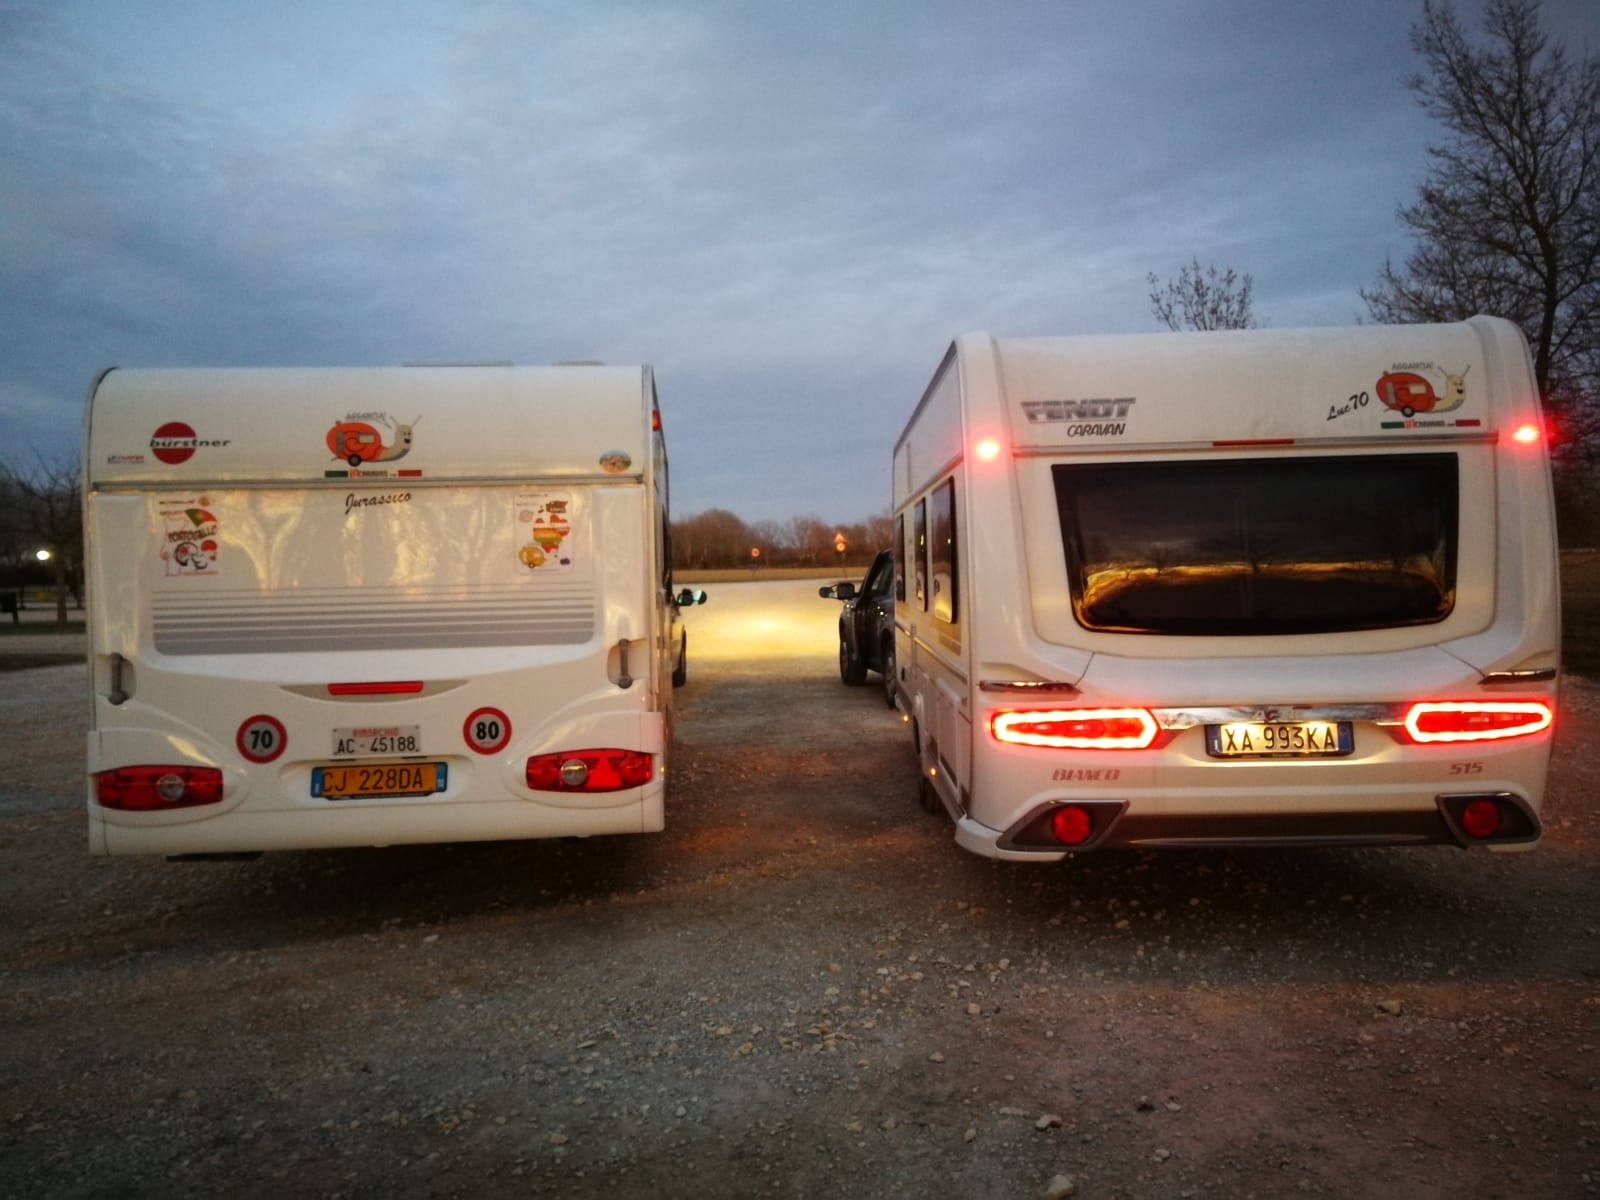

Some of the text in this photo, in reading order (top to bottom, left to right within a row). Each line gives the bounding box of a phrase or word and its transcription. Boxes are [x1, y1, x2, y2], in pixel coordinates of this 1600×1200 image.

[1020, 397, 1136, 424] FENDT
[1067, 423, 1126, 437] CARAVAN
[344, 492, 412, 515] Jurassico
[250, 730, 273, 750] 70
[352, 727, 400, 738] RIMORCHIO
[476, 721, 499, 740] 80
[1224, 728, 1253, 751] XA
[1263, 726, 1336, 750] 993KA
[1448, 761, 1485, 775] 515
[358, 767, 423, 791] 228DA
